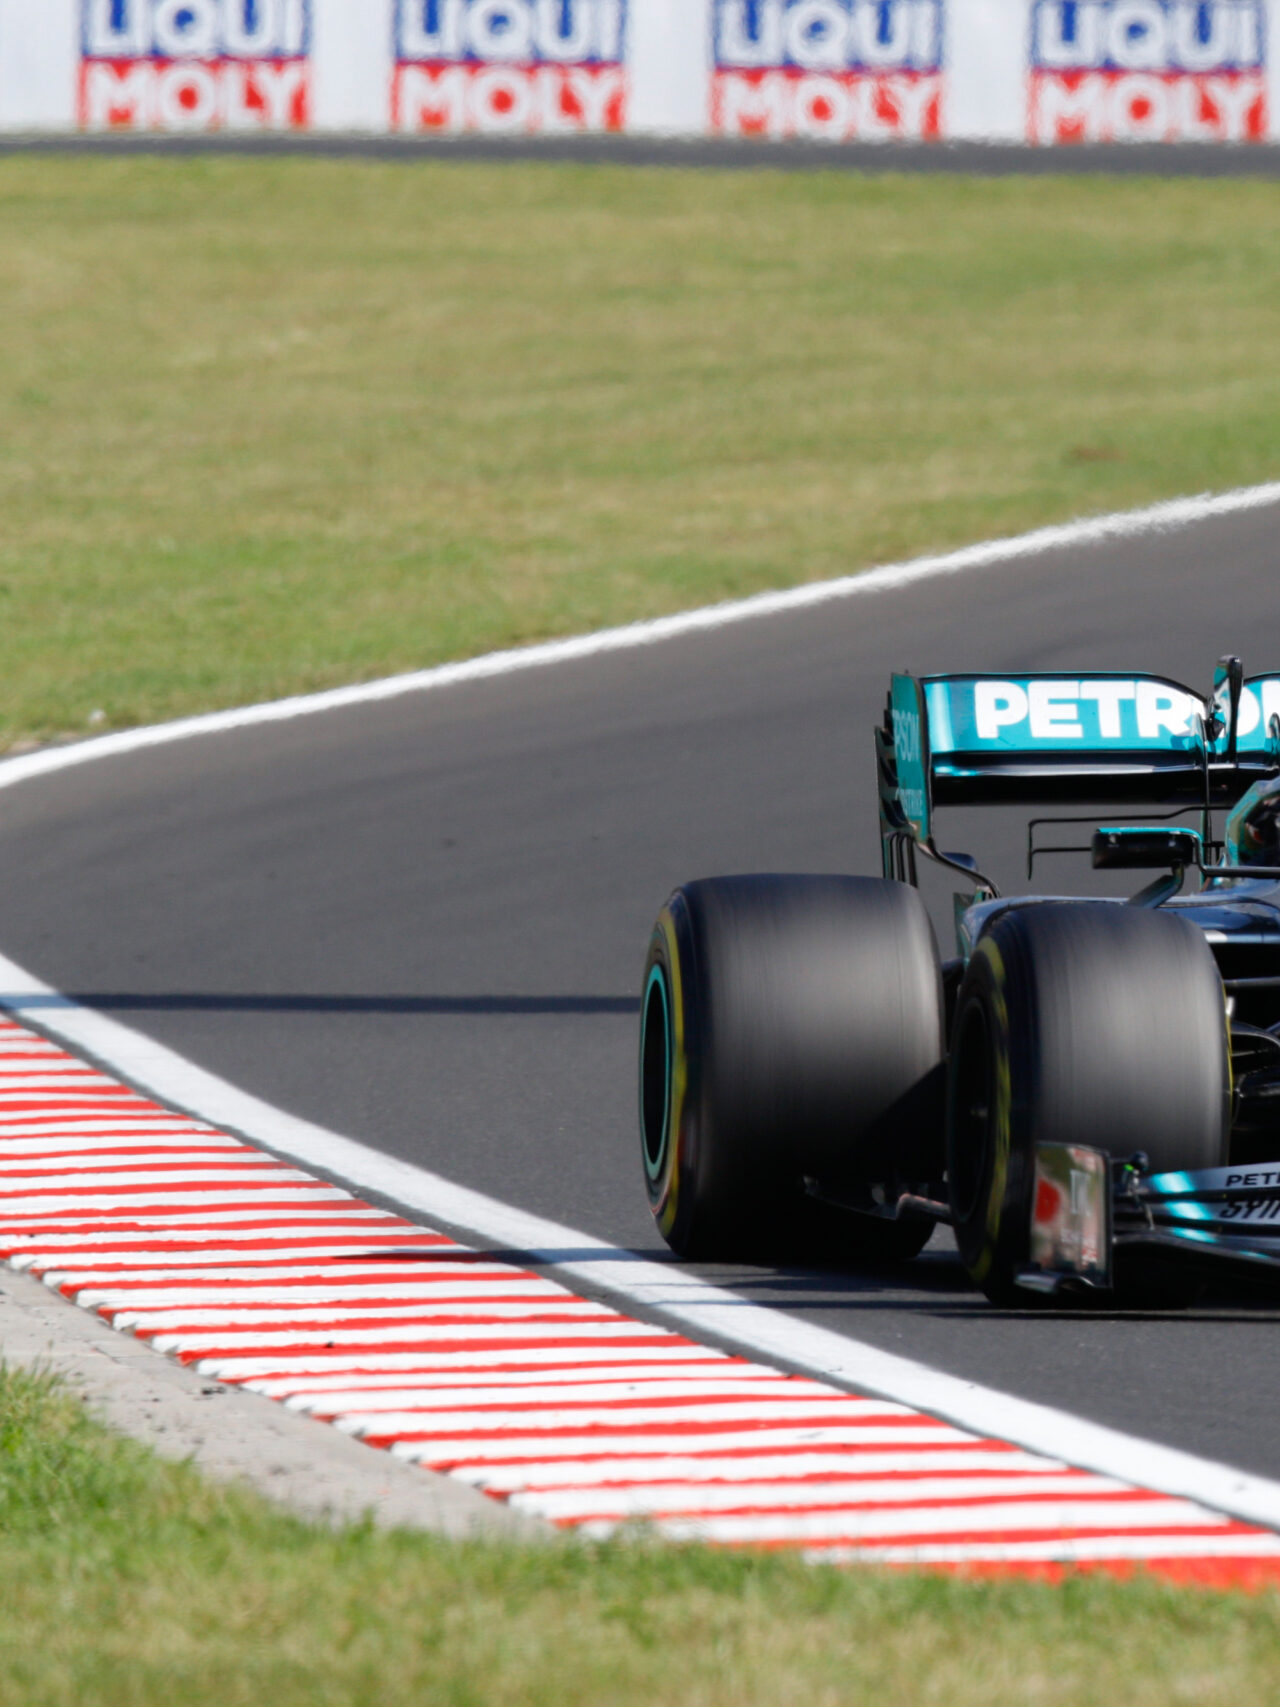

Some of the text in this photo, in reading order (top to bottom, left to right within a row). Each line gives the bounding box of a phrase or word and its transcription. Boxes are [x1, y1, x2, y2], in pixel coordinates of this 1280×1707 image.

[91, 0, 304, 54] LIQUI
[403, 0, 619, 58] LIQUI
[721, 0, 936, 64] LIQUI
[1040, 0, 1257, 66] LIQUI
[89, 63, 305, 127] MOLY
[401, 66, 620, 132] MOLY
[722, 73, 937, 139] MOLY
[1040, 72, 1260, 140] MOLY
